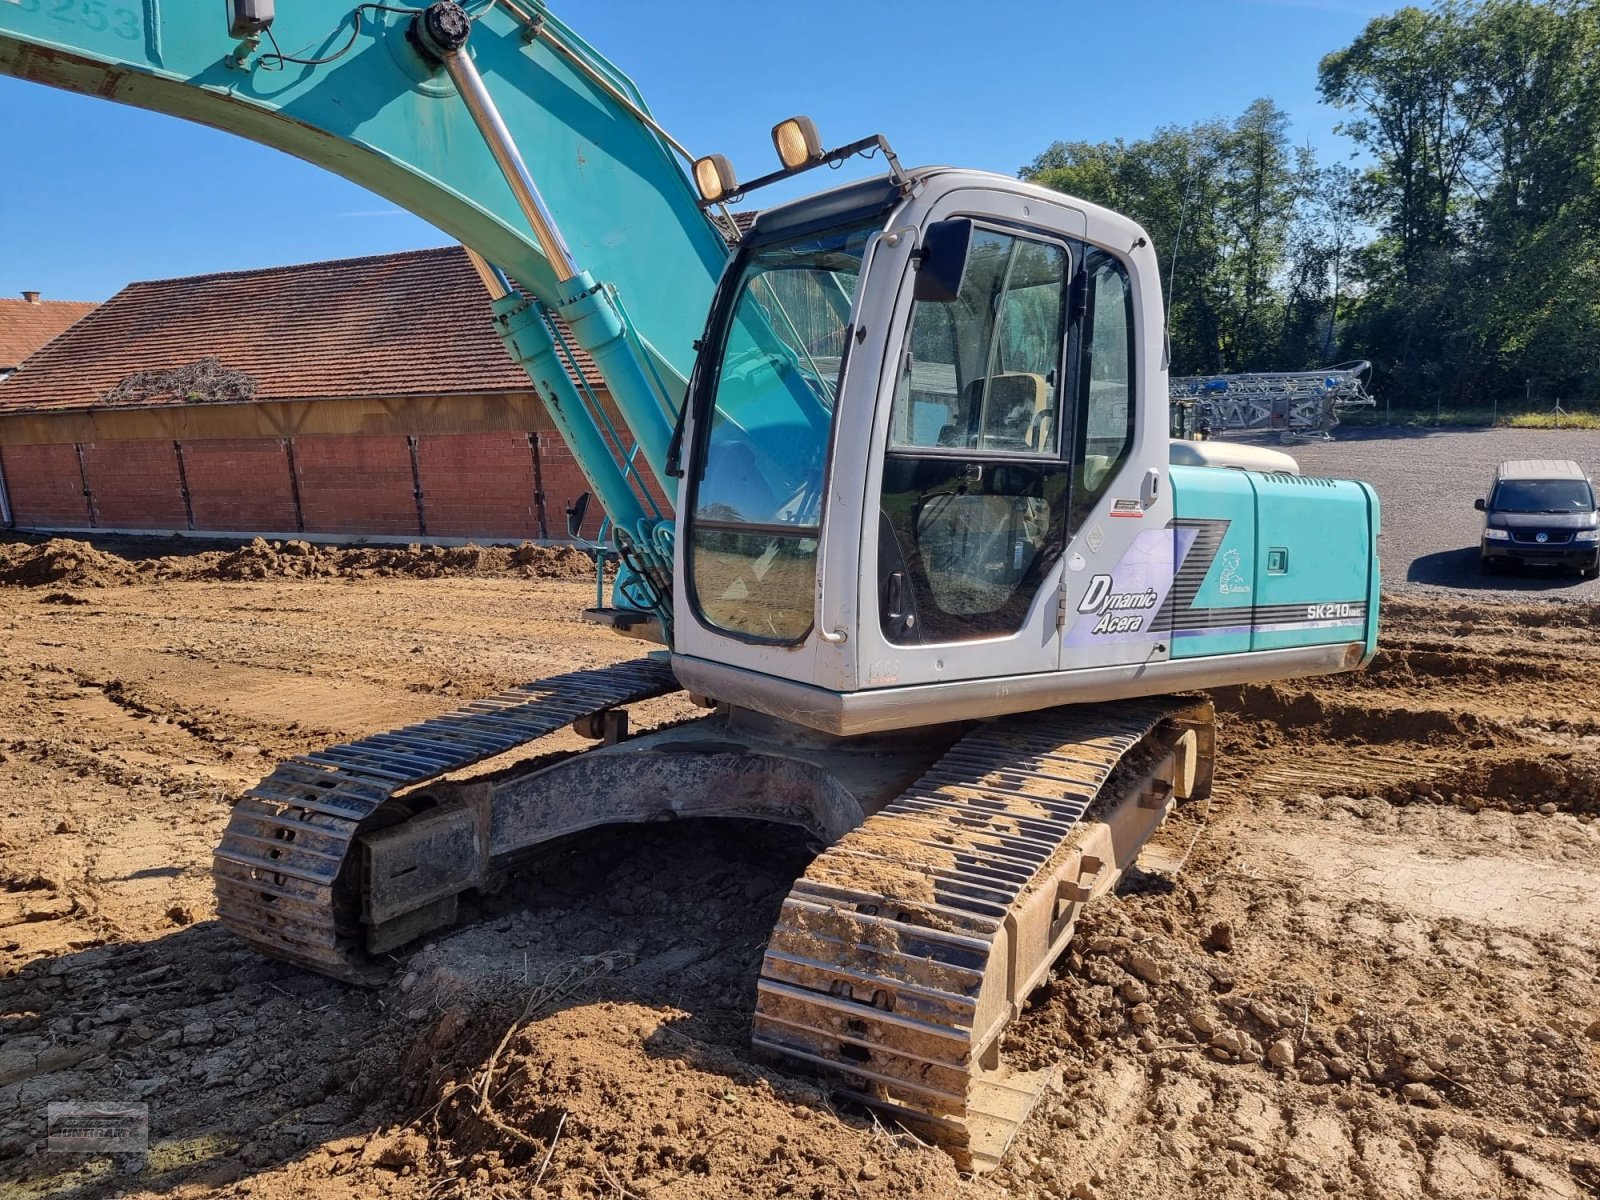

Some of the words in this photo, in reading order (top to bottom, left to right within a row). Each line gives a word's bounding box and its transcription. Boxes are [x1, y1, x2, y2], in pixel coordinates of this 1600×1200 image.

[1077, 574, 1157, 616] Dynamic
[1307, 604, 1349, 619] SK210
[1091, 612, 1143, 634] Acera
